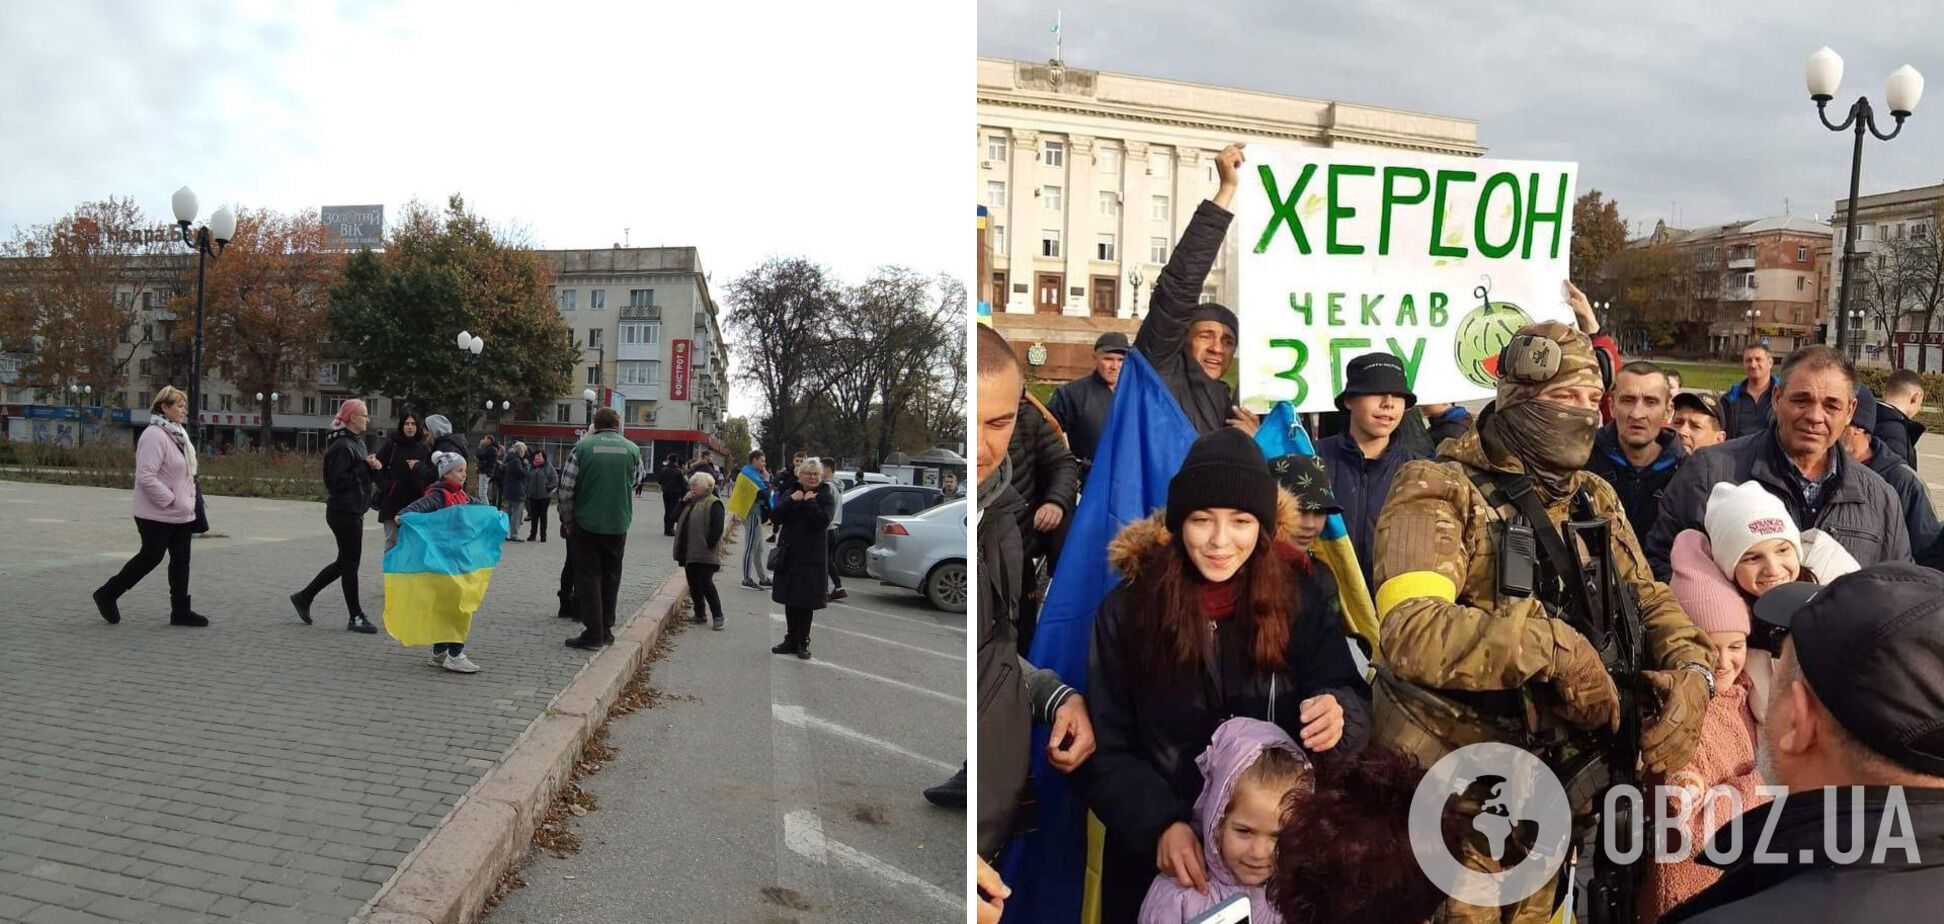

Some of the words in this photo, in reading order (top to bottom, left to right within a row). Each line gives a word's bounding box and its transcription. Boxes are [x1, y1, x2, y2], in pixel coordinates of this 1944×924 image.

[1252, 163, 1568, 259] ХЕРСОН
[1289, 292, 1449, 326] ЧЕКАВ
[675, 353, 685, 396] ФОКСТРОТ
